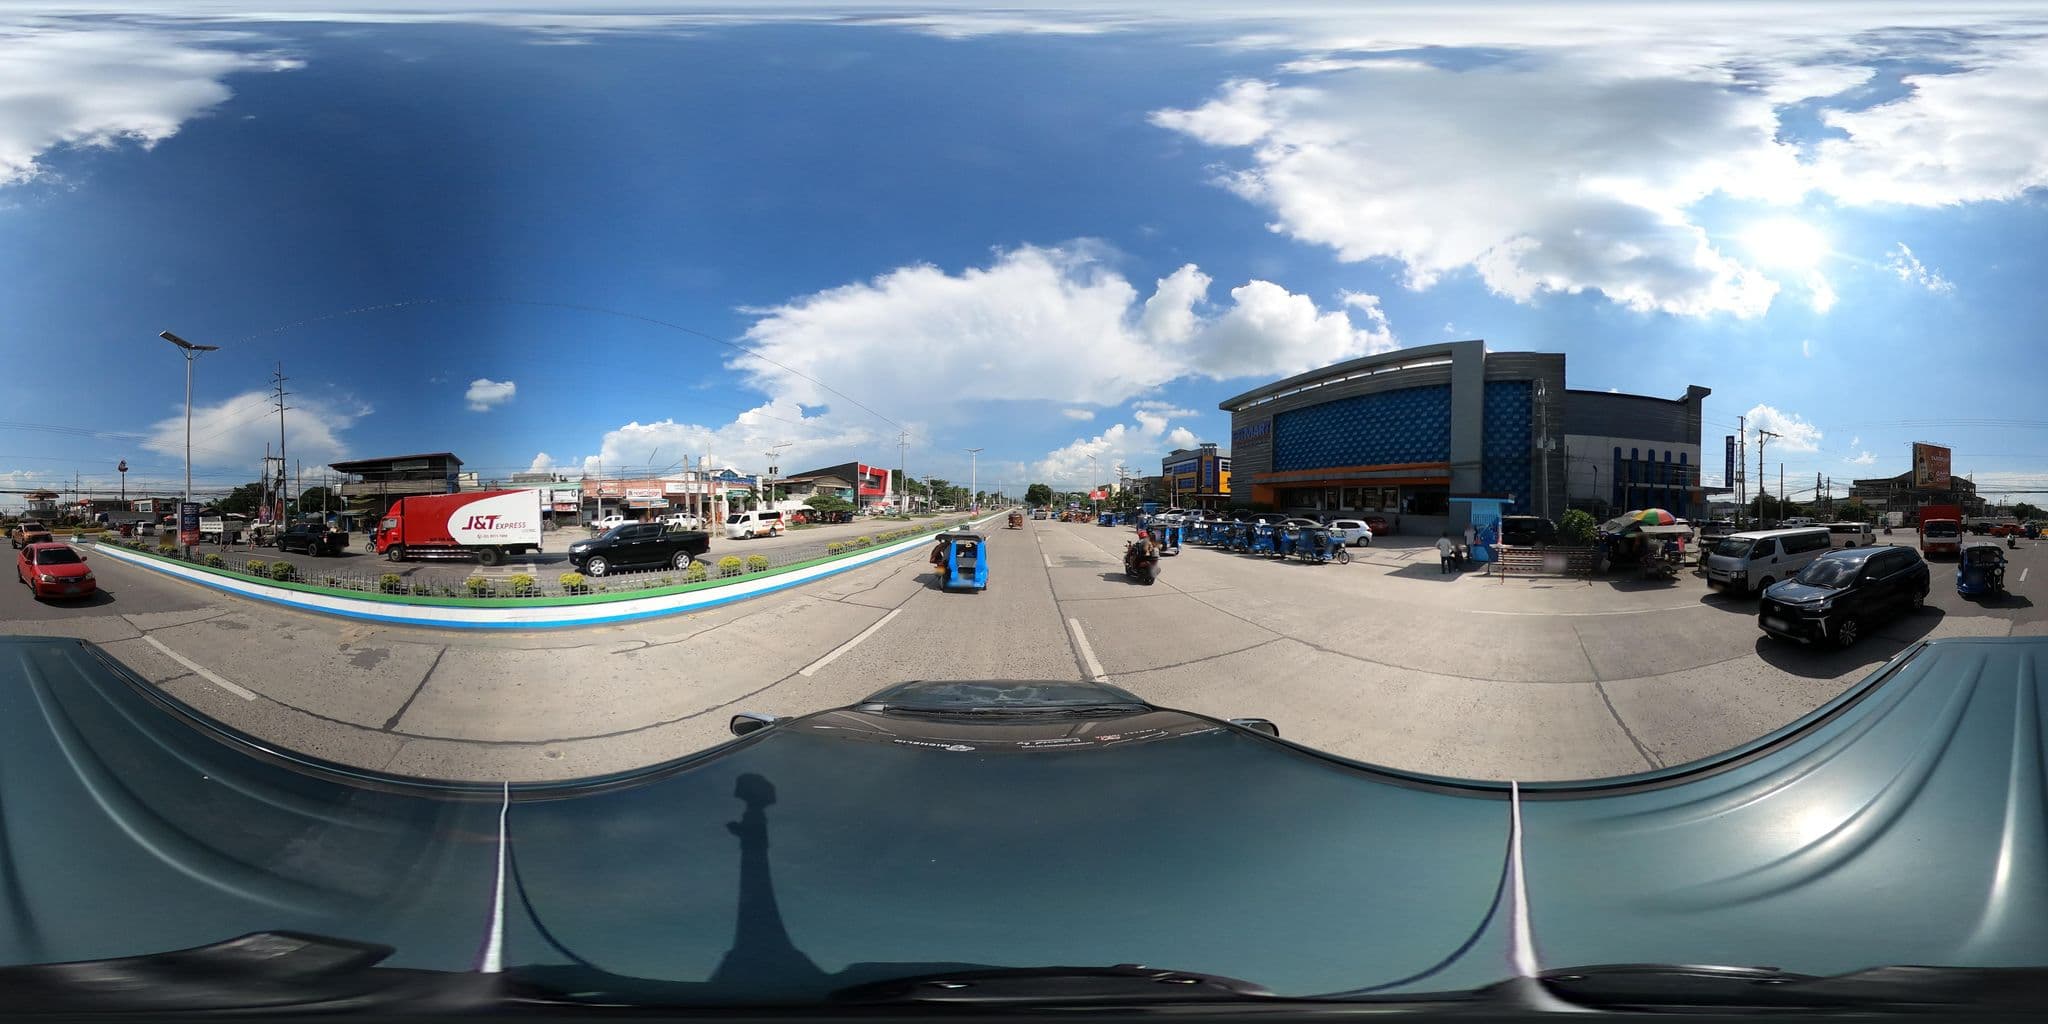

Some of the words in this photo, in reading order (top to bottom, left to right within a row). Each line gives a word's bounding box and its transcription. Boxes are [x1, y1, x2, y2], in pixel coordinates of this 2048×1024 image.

[462, 515, 501, 530] J&T
[495, 522, 526, 530] EXPRESS
[894, 739, 951, 748] MICHELIN
